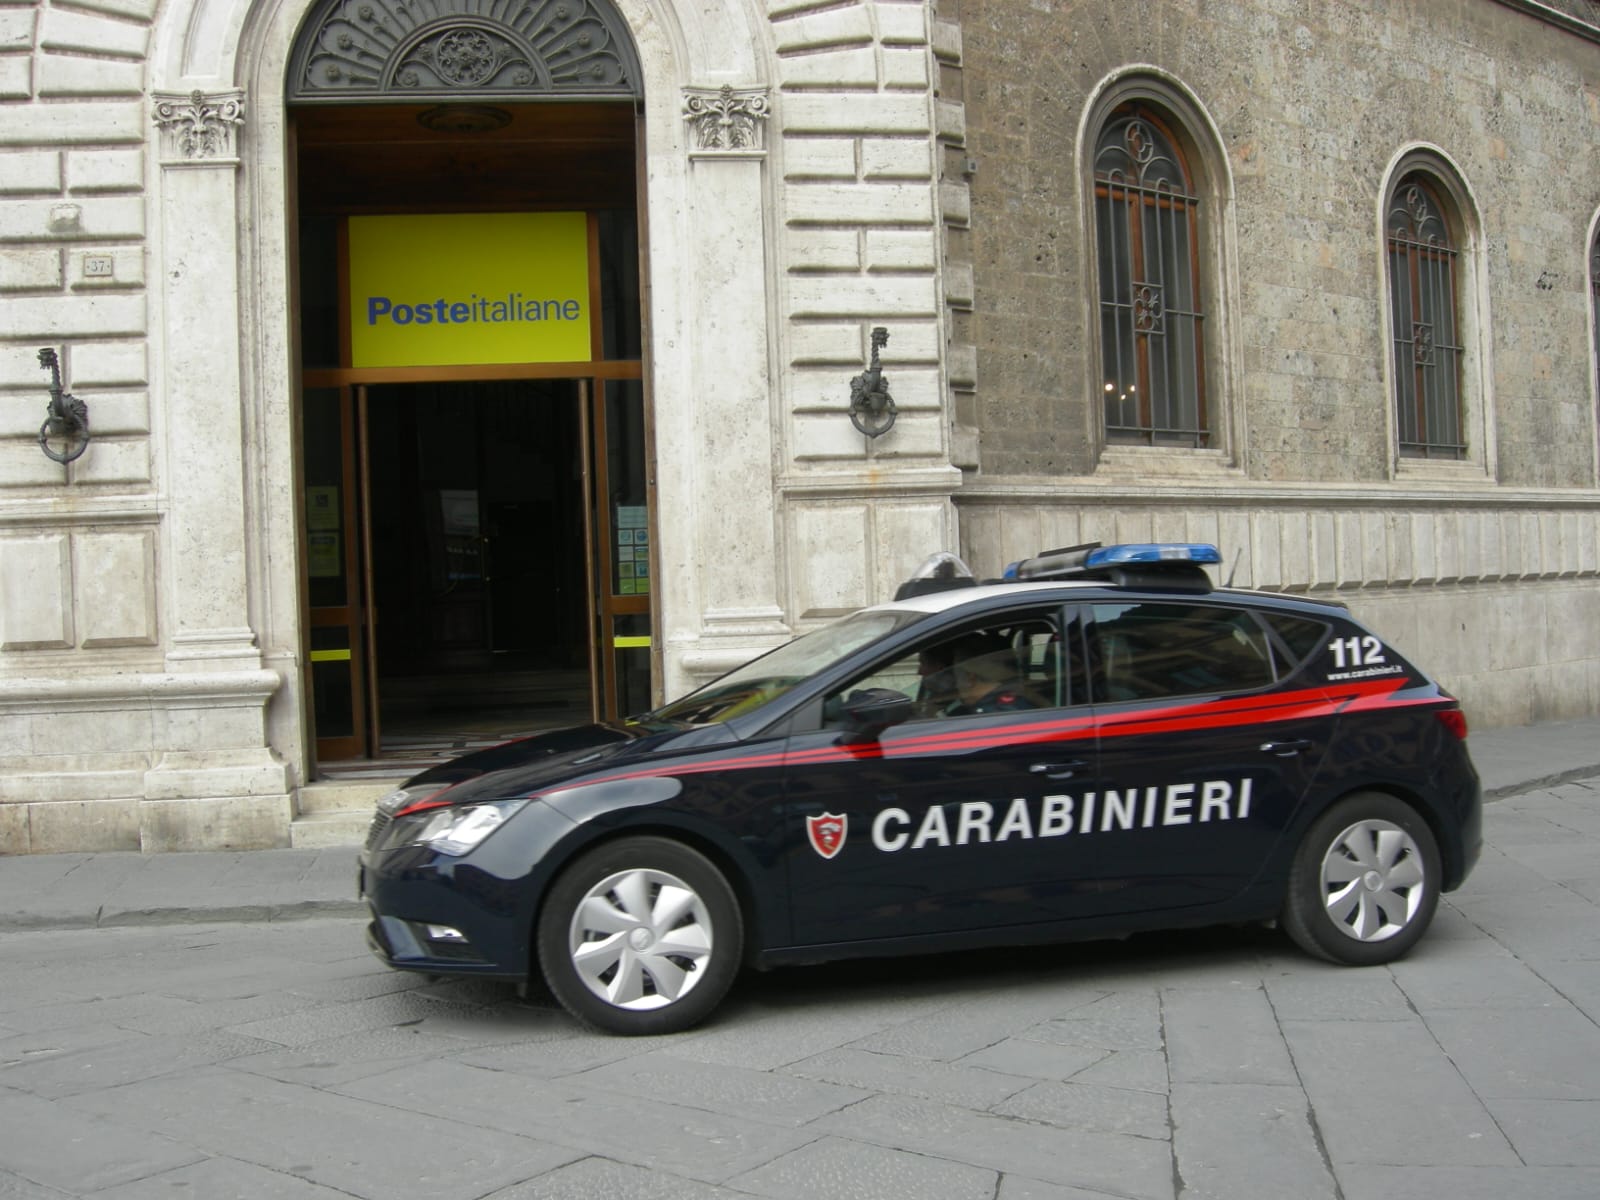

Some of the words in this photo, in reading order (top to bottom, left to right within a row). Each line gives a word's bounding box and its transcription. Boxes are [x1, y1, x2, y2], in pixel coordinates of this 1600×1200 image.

[367, 293, 580, 326] Posteitaliane
[1328, 636, 1385, 668] 112
[872, 778, 1253, 852] CARABINIERI
